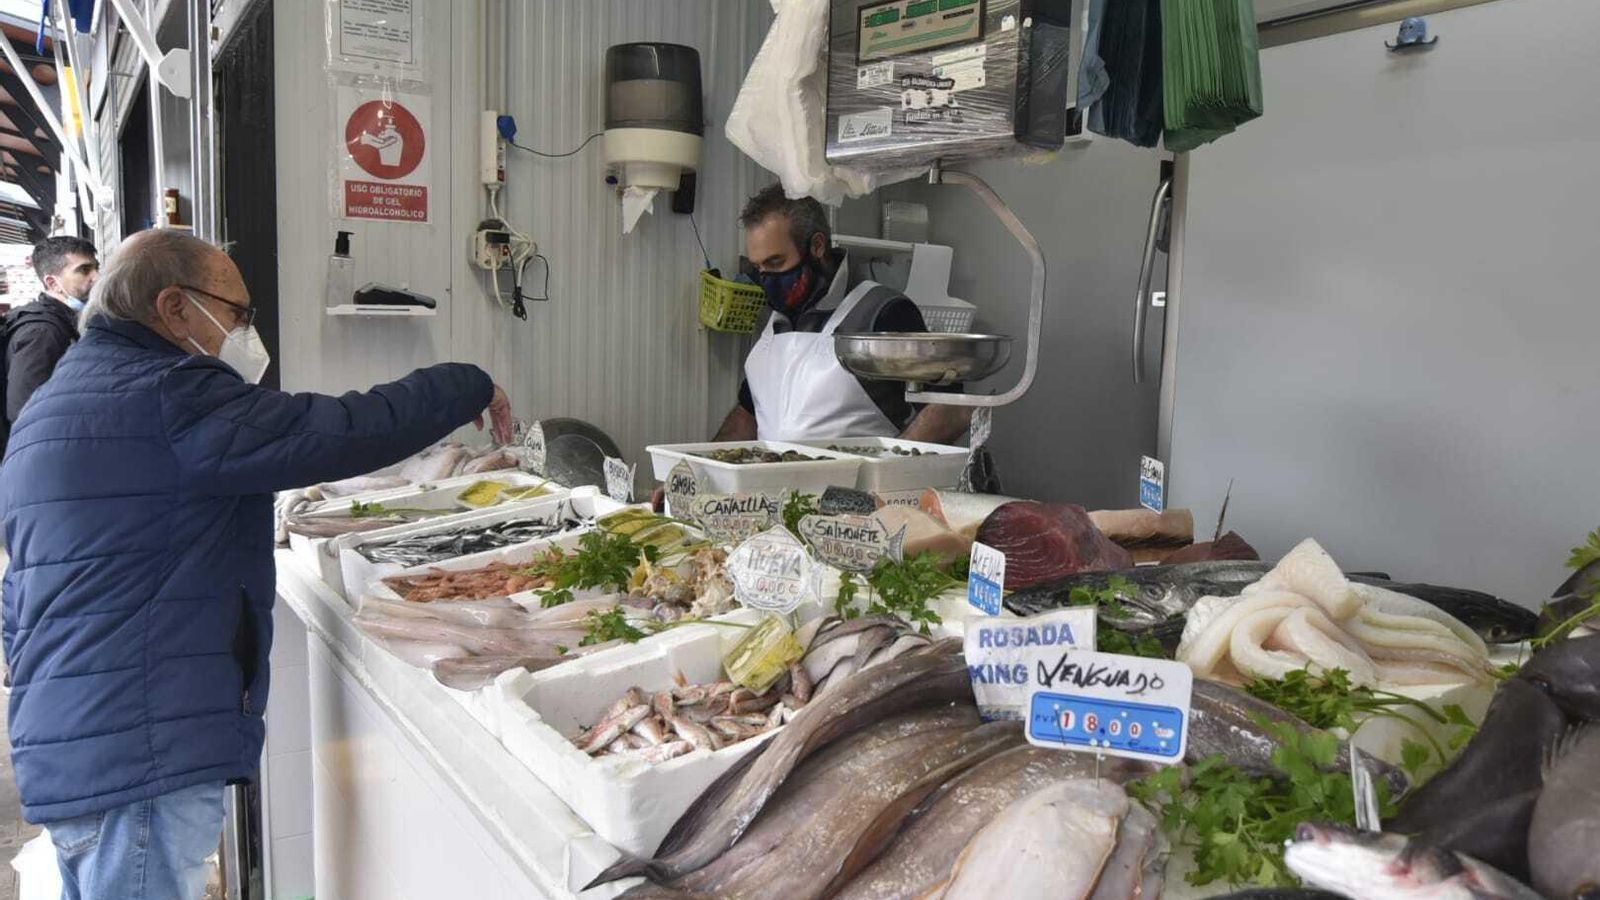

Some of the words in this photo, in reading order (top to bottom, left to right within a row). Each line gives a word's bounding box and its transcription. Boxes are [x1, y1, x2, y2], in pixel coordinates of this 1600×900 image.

[350, 184, 368, 193] USO
[369, 185, 422, 197] OBLIGATORIO
[385, 198, 401, 206] GEL
[979, 623, 1075, 648] ROSADA
[969, 663, 1029, 684] KING
